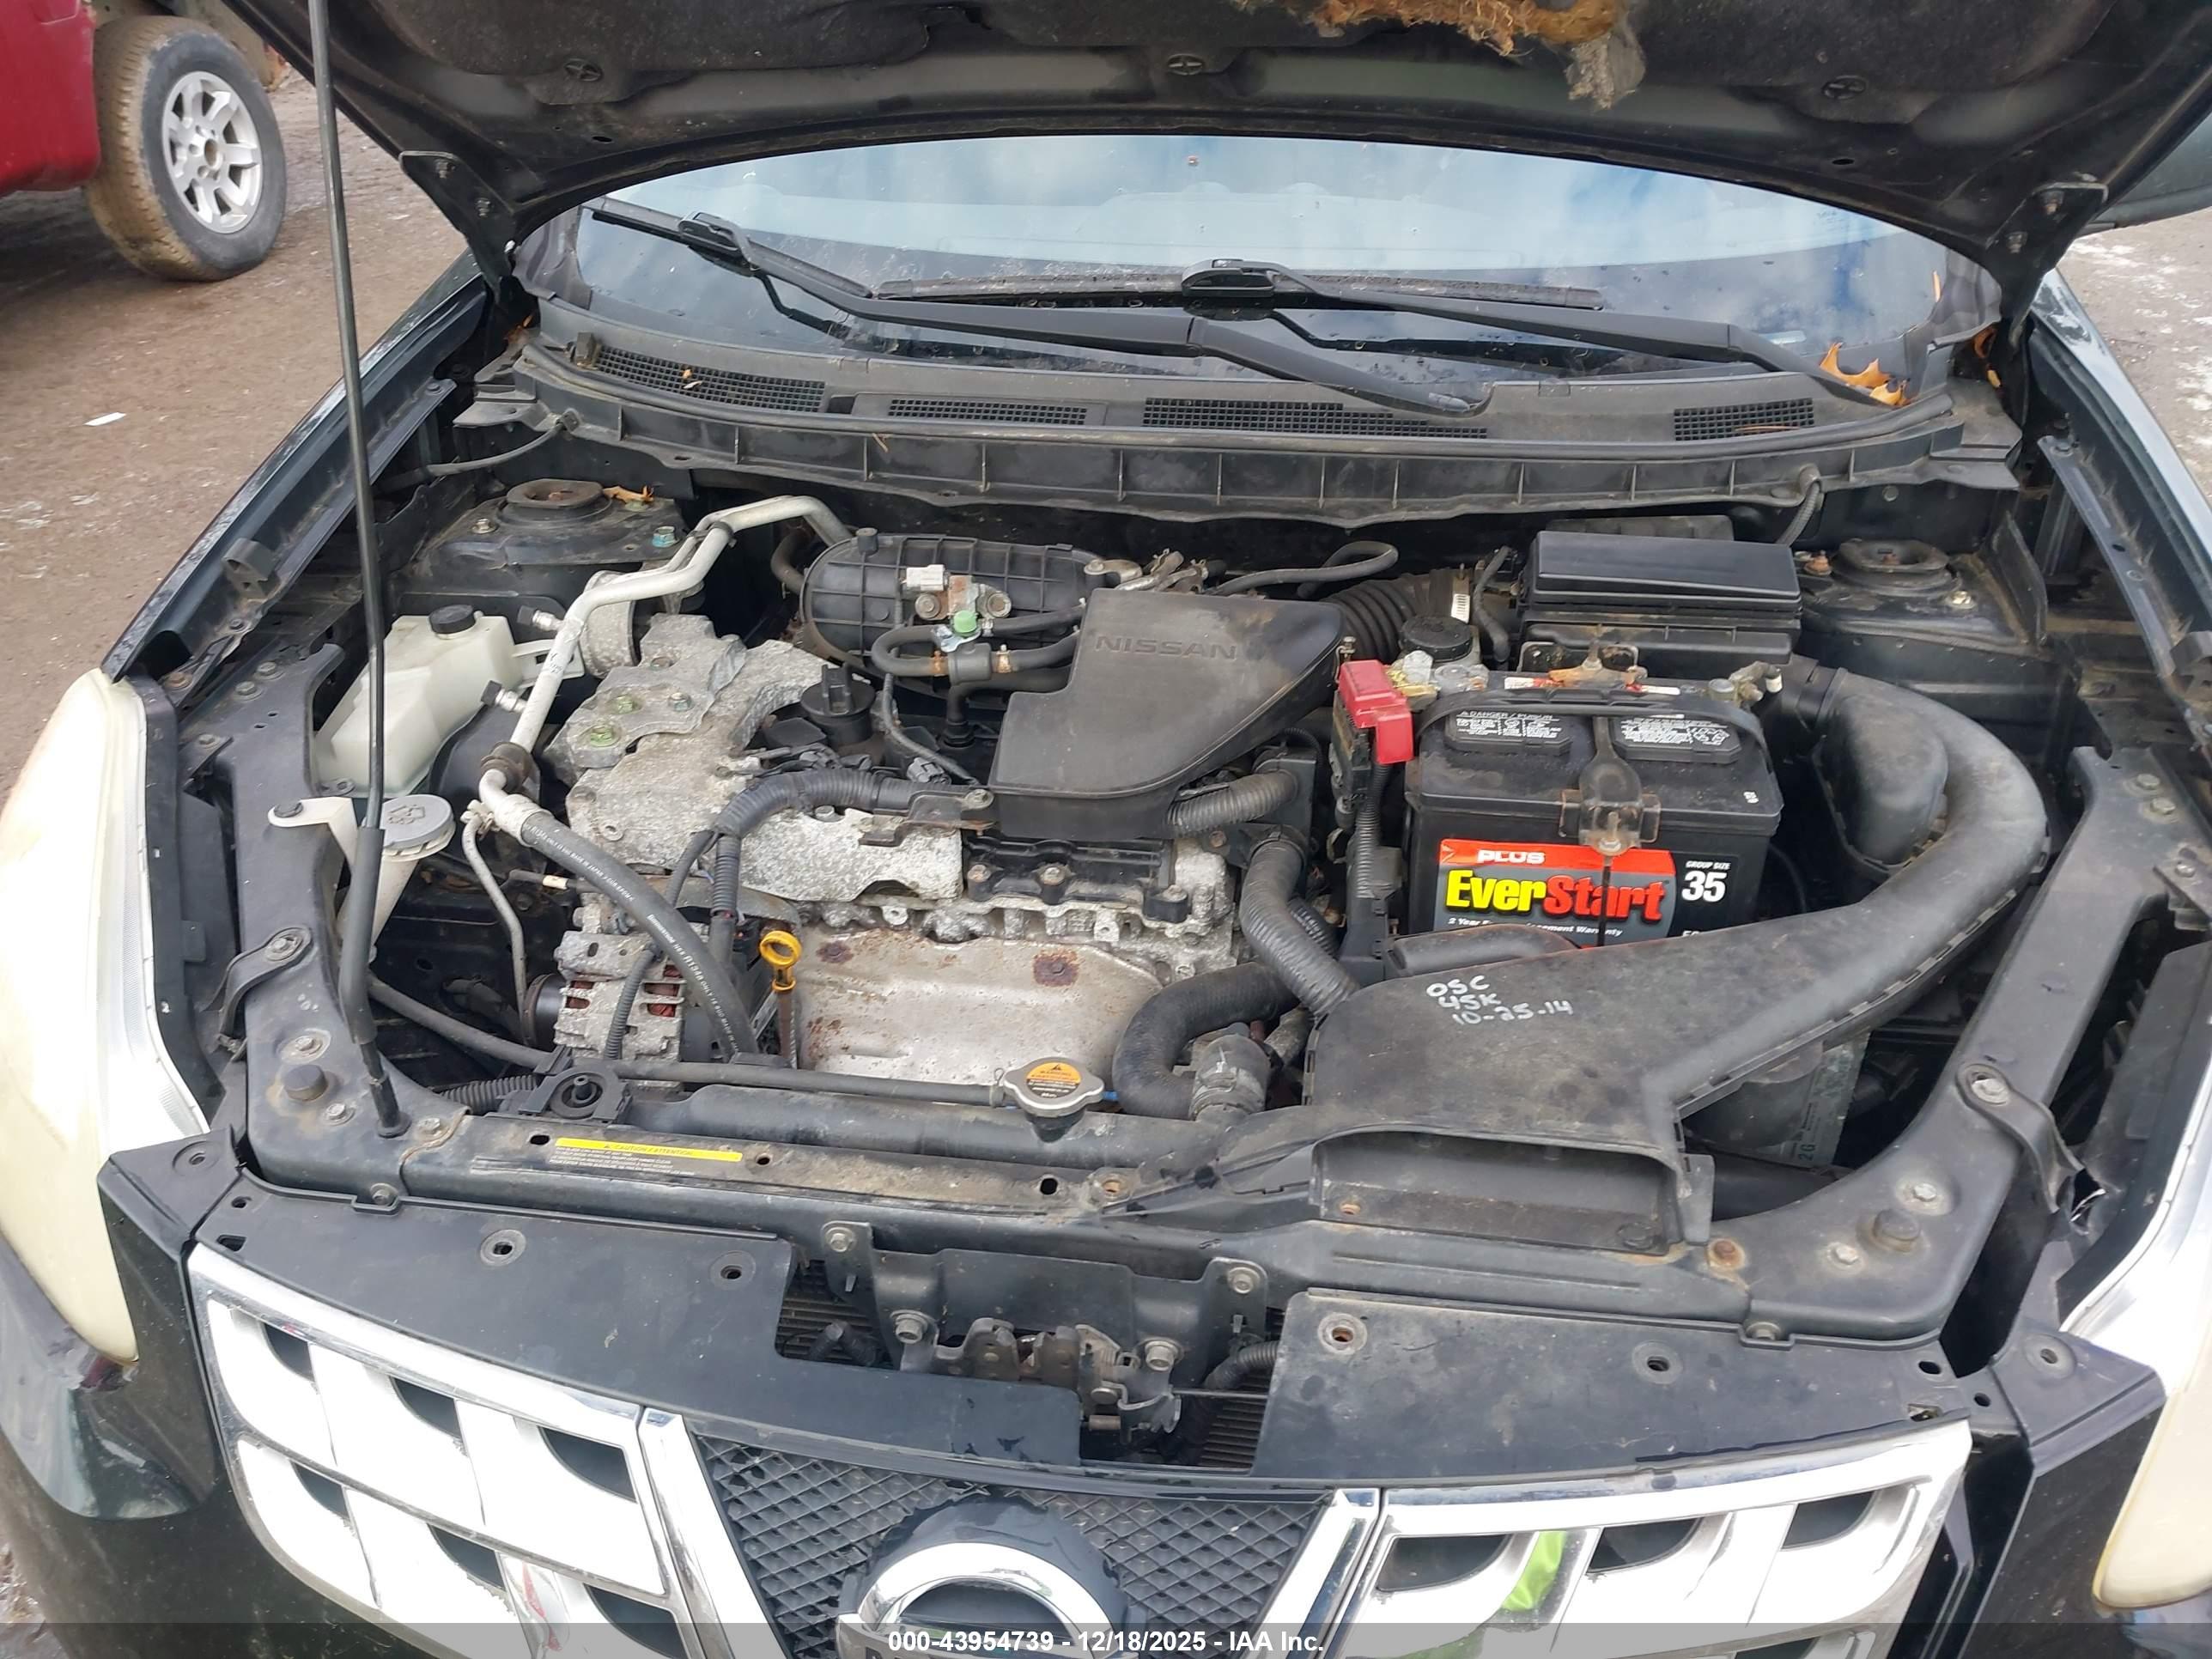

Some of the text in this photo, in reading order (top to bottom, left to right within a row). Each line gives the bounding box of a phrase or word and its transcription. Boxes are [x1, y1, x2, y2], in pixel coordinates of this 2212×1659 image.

[1094, 635, 1237, 660] NISSAN
[1477, 849, 1545, 864] PLUS
[1446, 869, 1666, 921] EverStart
[1681, 870, 1727, 902] 35
[1426, 975, 1490, 997] OSC
[1452, 1000, 1573, 1024] 10-25-14
